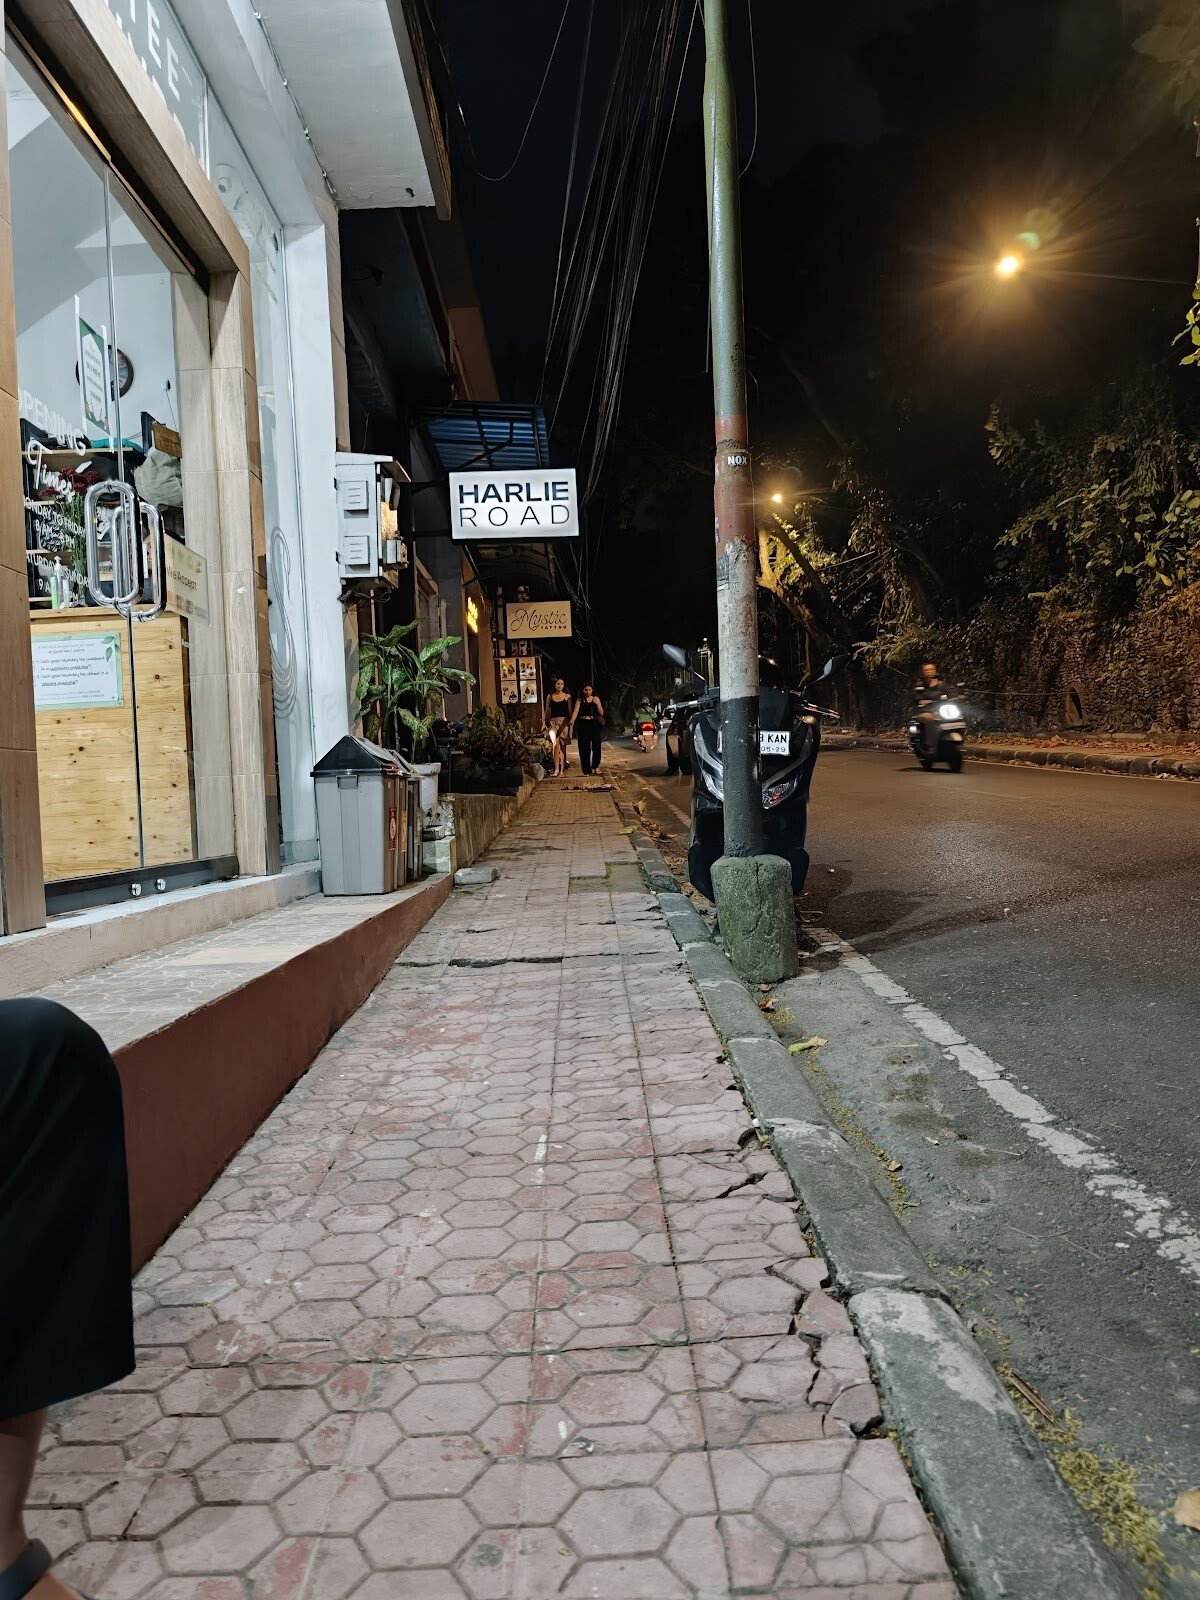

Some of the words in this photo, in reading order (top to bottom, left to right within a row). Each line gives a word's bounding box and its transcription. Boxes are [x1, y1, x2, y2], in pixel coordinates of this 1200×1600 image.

[18, 387, 86, 457] PENING
[458, 481, 569, 503] HARLIE
[23, 495, 52, 521] ONDAY
[460, 504, 570, 527] ROAD
[510, 608, 567, 632] Mystic
[767, 733, 787, 743] KAN
